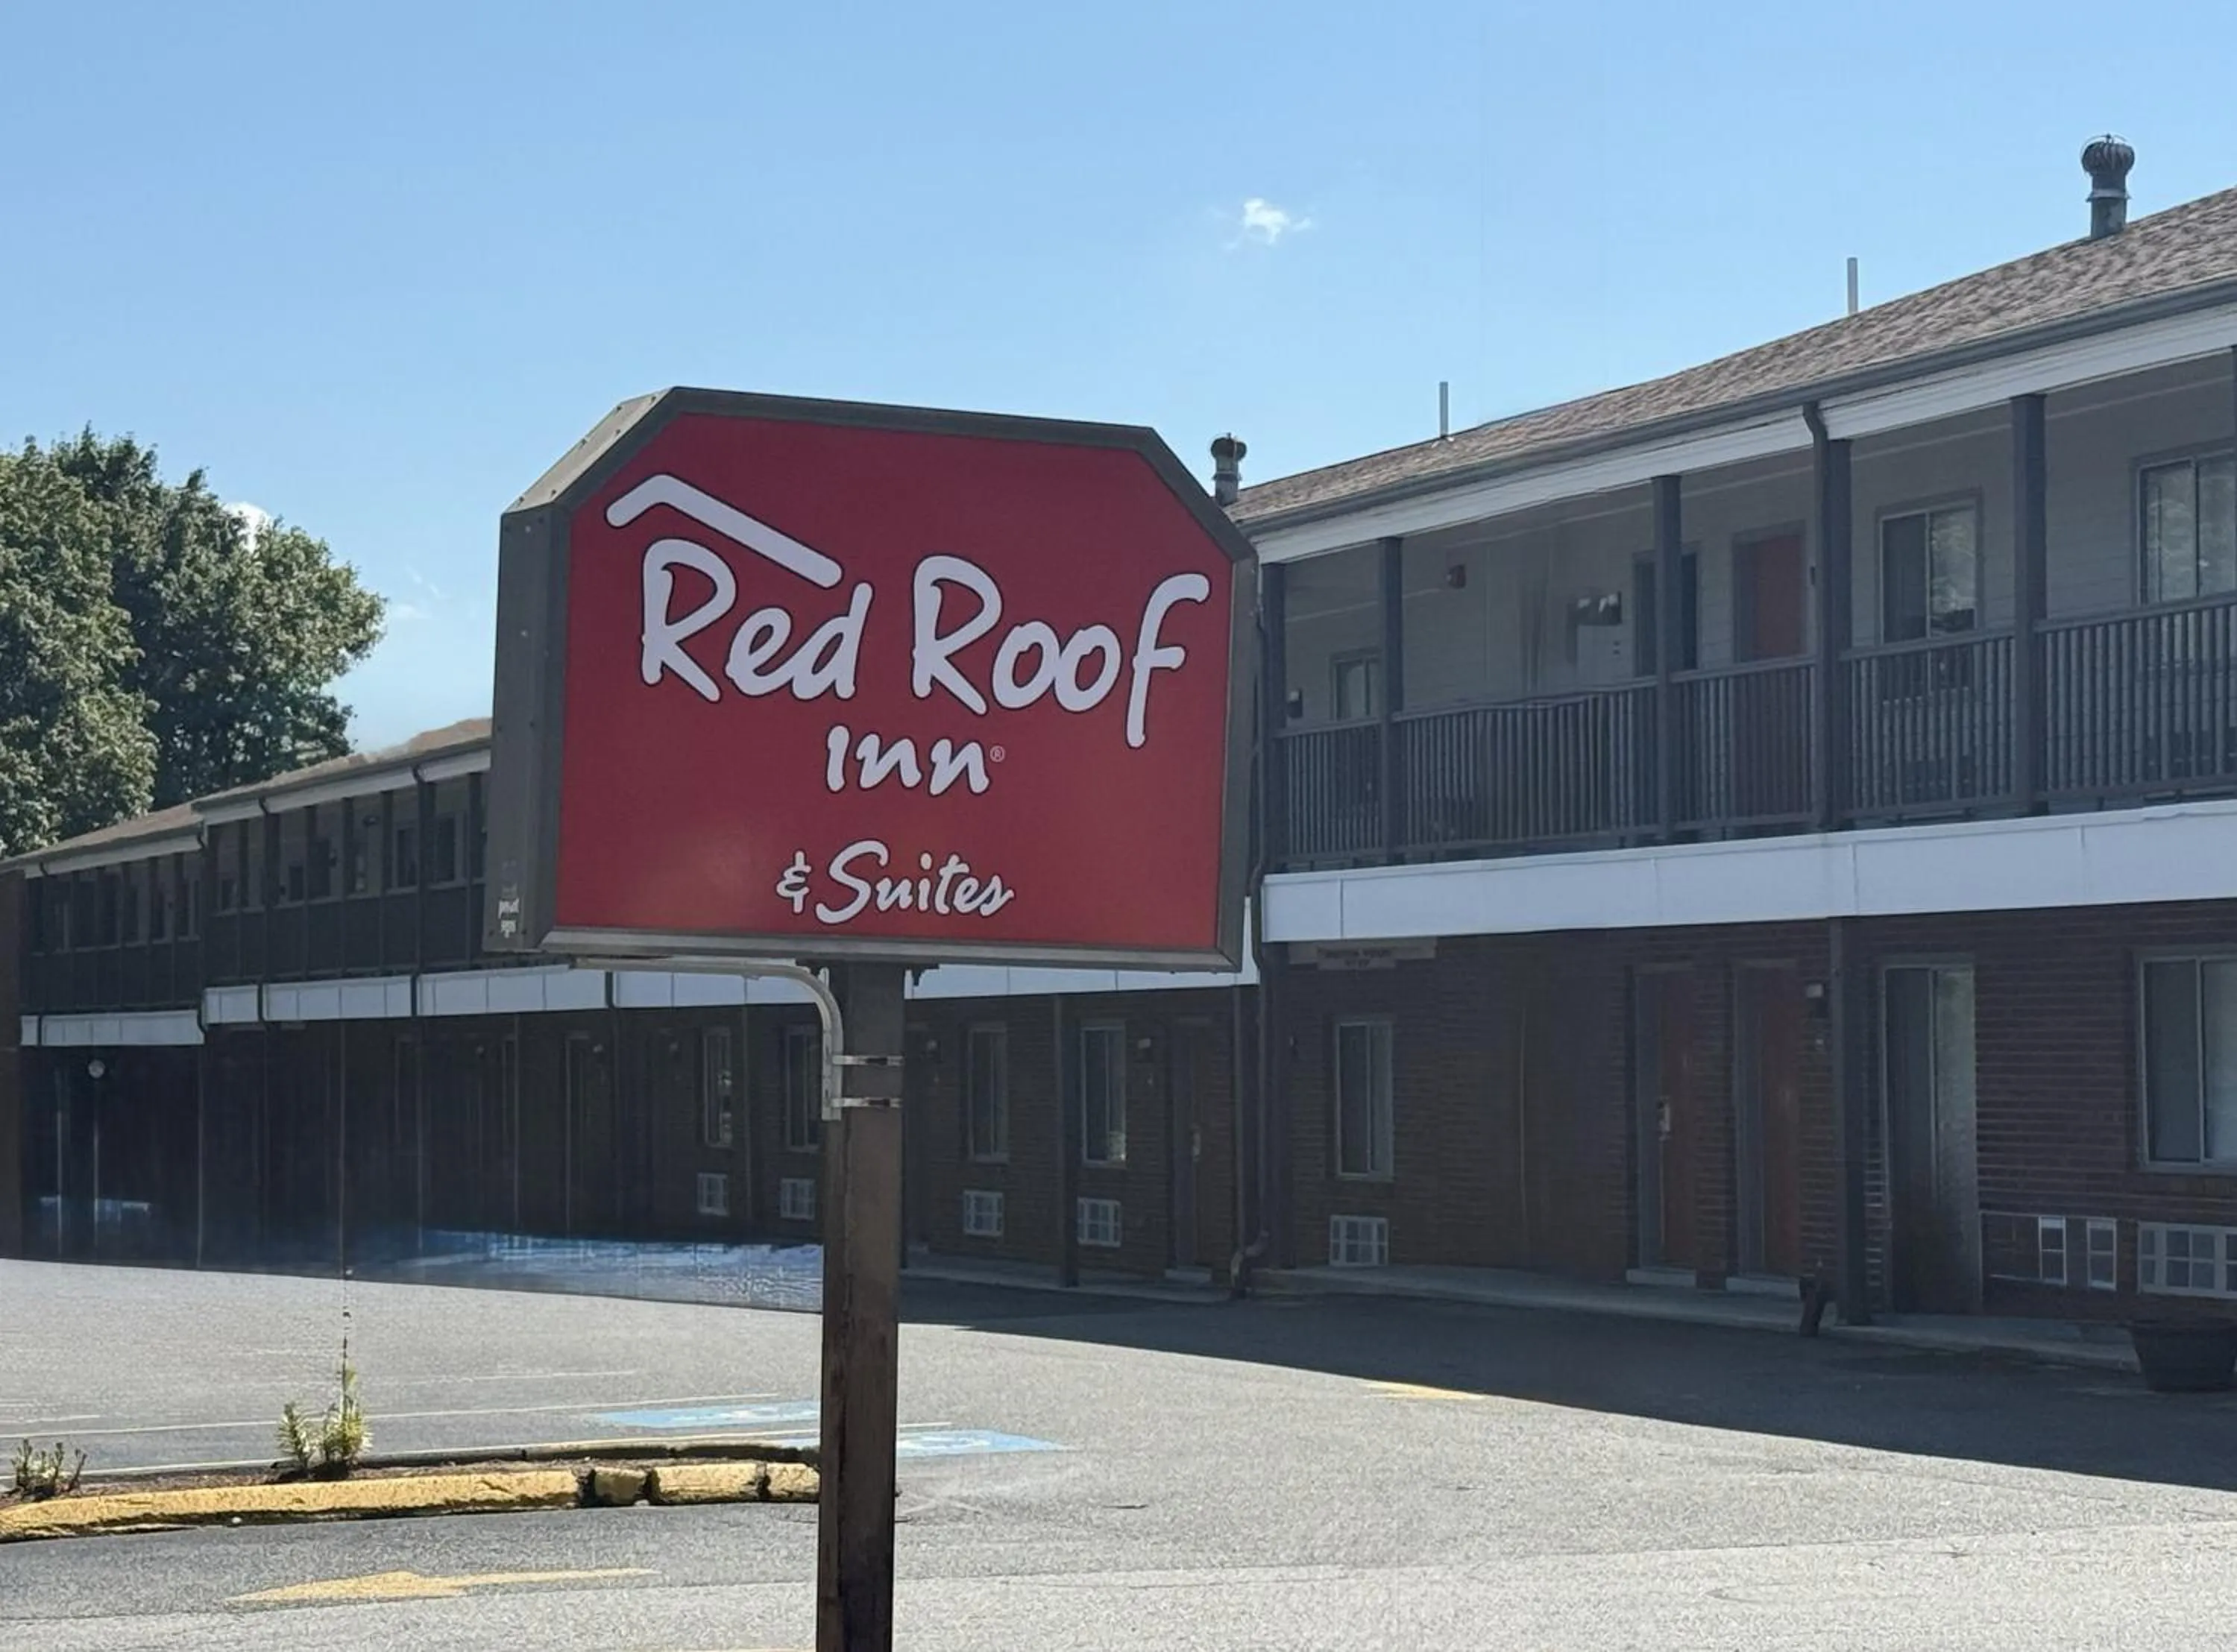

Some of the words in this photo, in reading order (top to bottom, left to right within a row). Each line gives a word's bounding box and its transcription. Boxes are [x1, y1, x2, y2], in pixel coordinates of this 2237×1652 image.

[641, 538, 873, 702] Red
[911, 555, 1210, 748] Roof
[775, 850, 812, 914] &
[815, 839, 1015, 924] Suites
